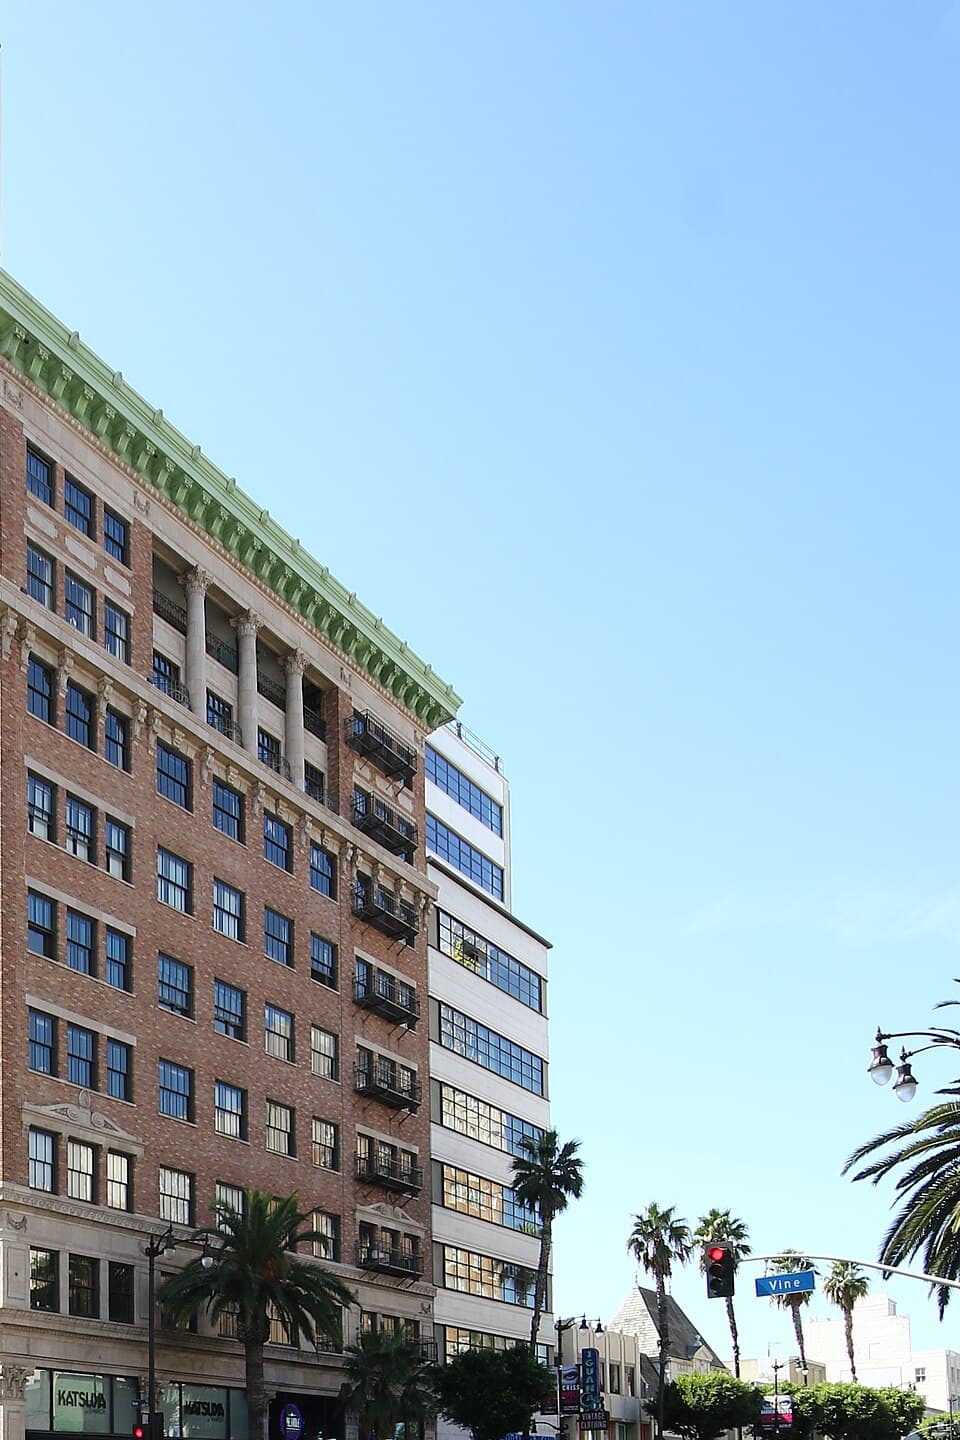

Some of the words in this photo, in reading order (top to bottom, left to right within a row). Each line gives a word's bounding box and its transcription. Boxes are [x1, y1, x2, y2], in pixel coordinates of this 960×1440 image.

[769, 1279, 801, 1291] Vine
[585, 1350, 595, 1402] IGUANA
[57, 1389, 106, 1409] KATSUYA
[582, 1412, 606, 1421] VINTAGE
